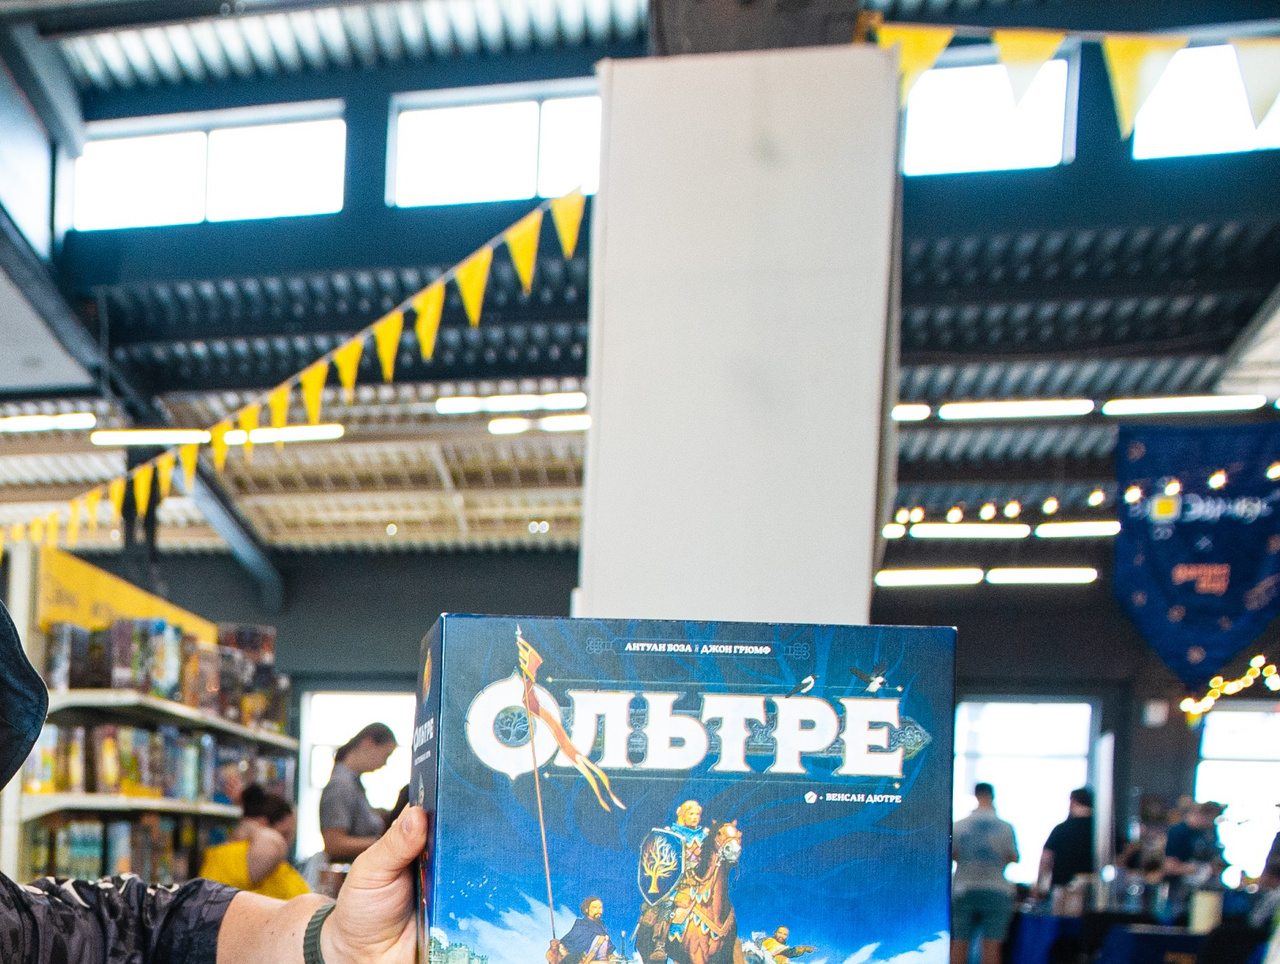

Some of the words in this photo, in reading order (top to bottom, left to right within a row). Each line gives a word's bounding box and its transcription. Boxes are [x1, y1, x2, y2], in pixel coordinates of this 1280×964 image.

[625, 642, 666, 652] АНТУАН
[667, 643, 693, 653] БОЗА
[700, 644, 733, 654] ДЖОН
[733, 645, 772, 655] ГРЮМФ
[466, 668, 905, 780] ОЛЬТРЕ
[825, 792, 865, 803] ВЕНСАН
[865, 794, 902, 804] ДЮТРЕ
